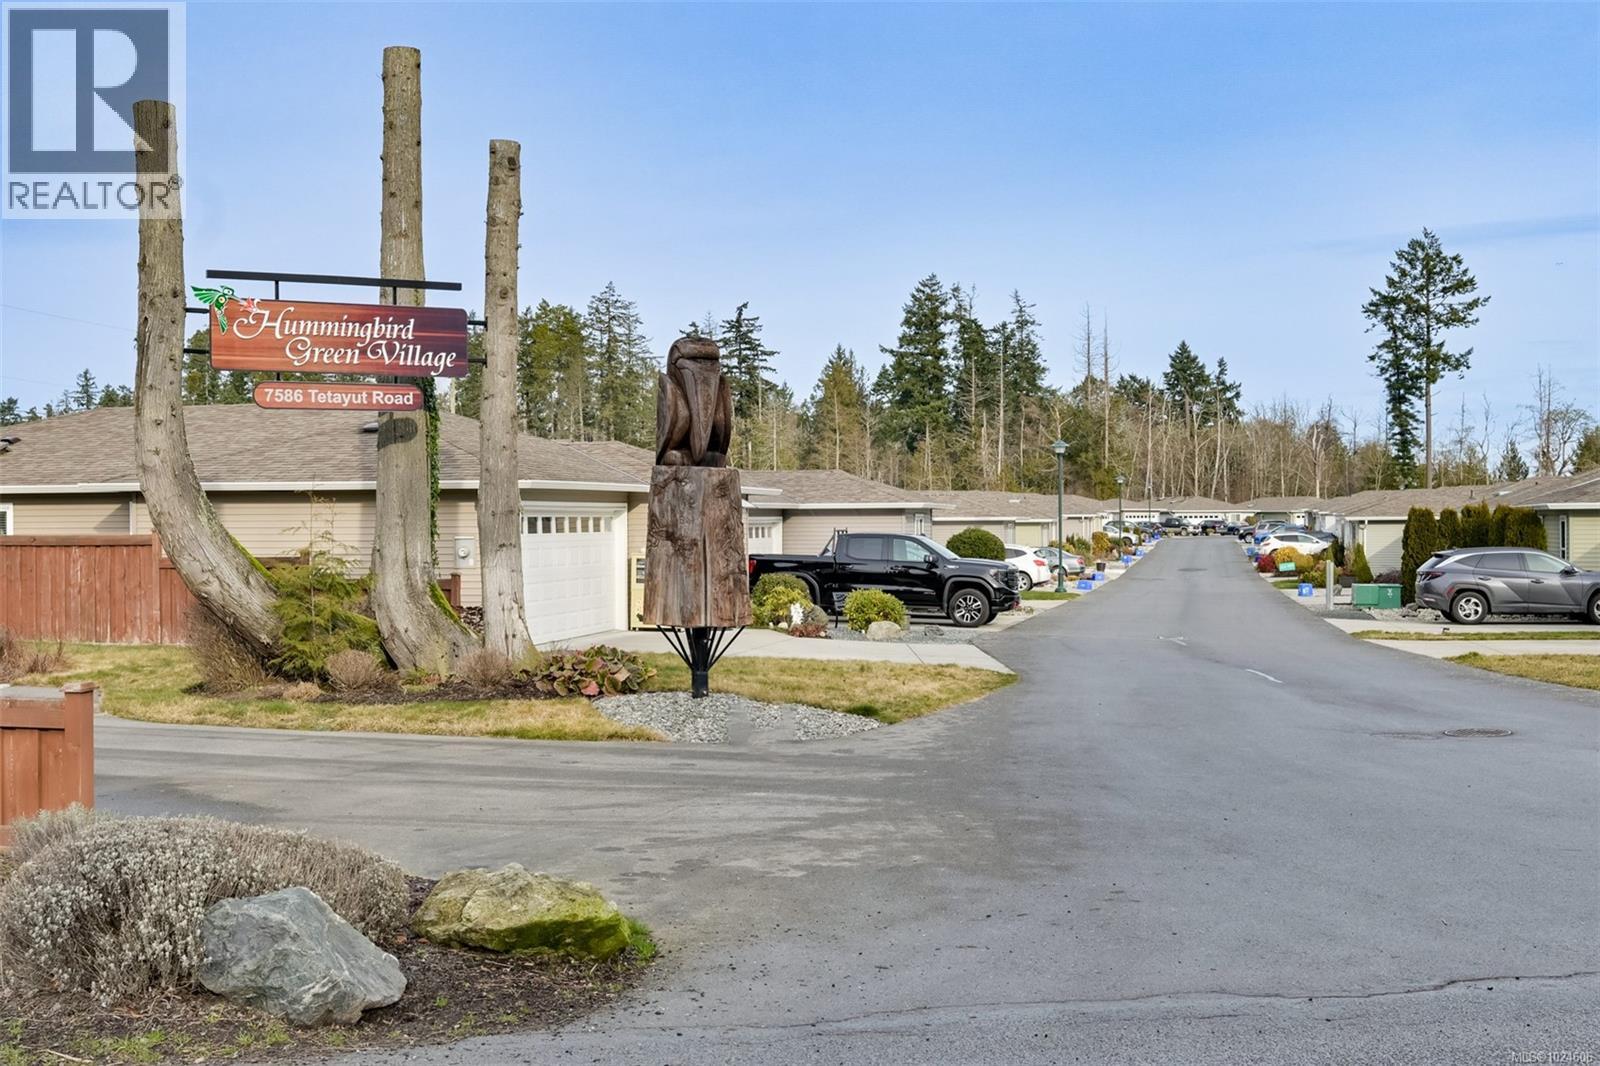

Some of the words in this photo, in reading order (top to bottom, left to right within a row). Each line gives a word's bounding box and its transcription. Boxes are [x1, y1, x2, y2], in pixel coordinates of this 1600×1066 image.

[233, 300, 414, 347] Hummingbird
[285, 337, 360, 366] Green
[367, 341, 456, 375] Village
[264, 389, 303, 402] 7586
[308, 389, 368, 405] Tetayut
[372, 390, 414, 405] Road
